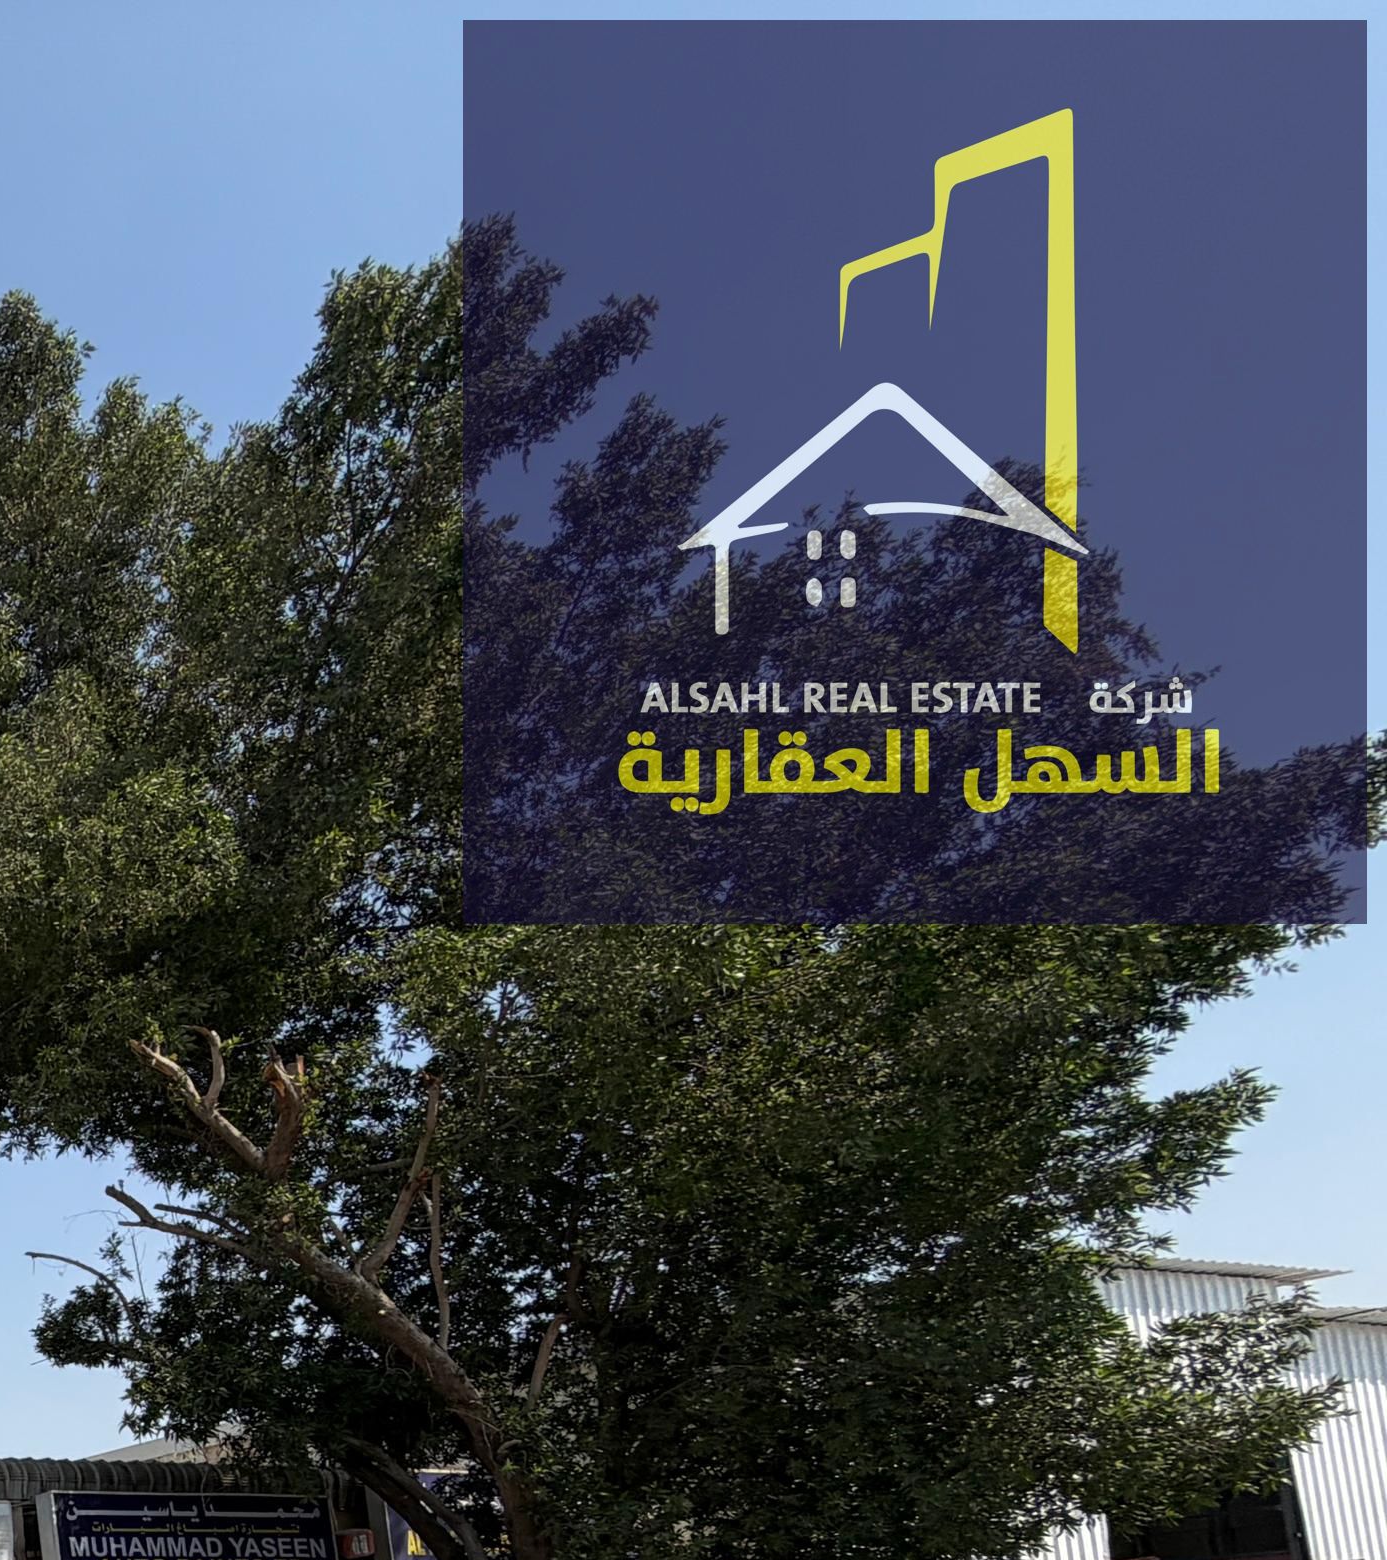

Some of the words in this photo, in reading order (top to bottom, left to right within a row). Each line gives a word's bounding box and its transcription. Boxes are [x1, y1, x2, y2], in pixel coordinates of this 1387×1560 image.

[65, 1499, 198, 1522] ياسين
[204, 1502, 321, 1519] محمد
[68, 1536, 224, 1558] MUHAMMAD
[228, 1537, 327, 1559] YASEEN
